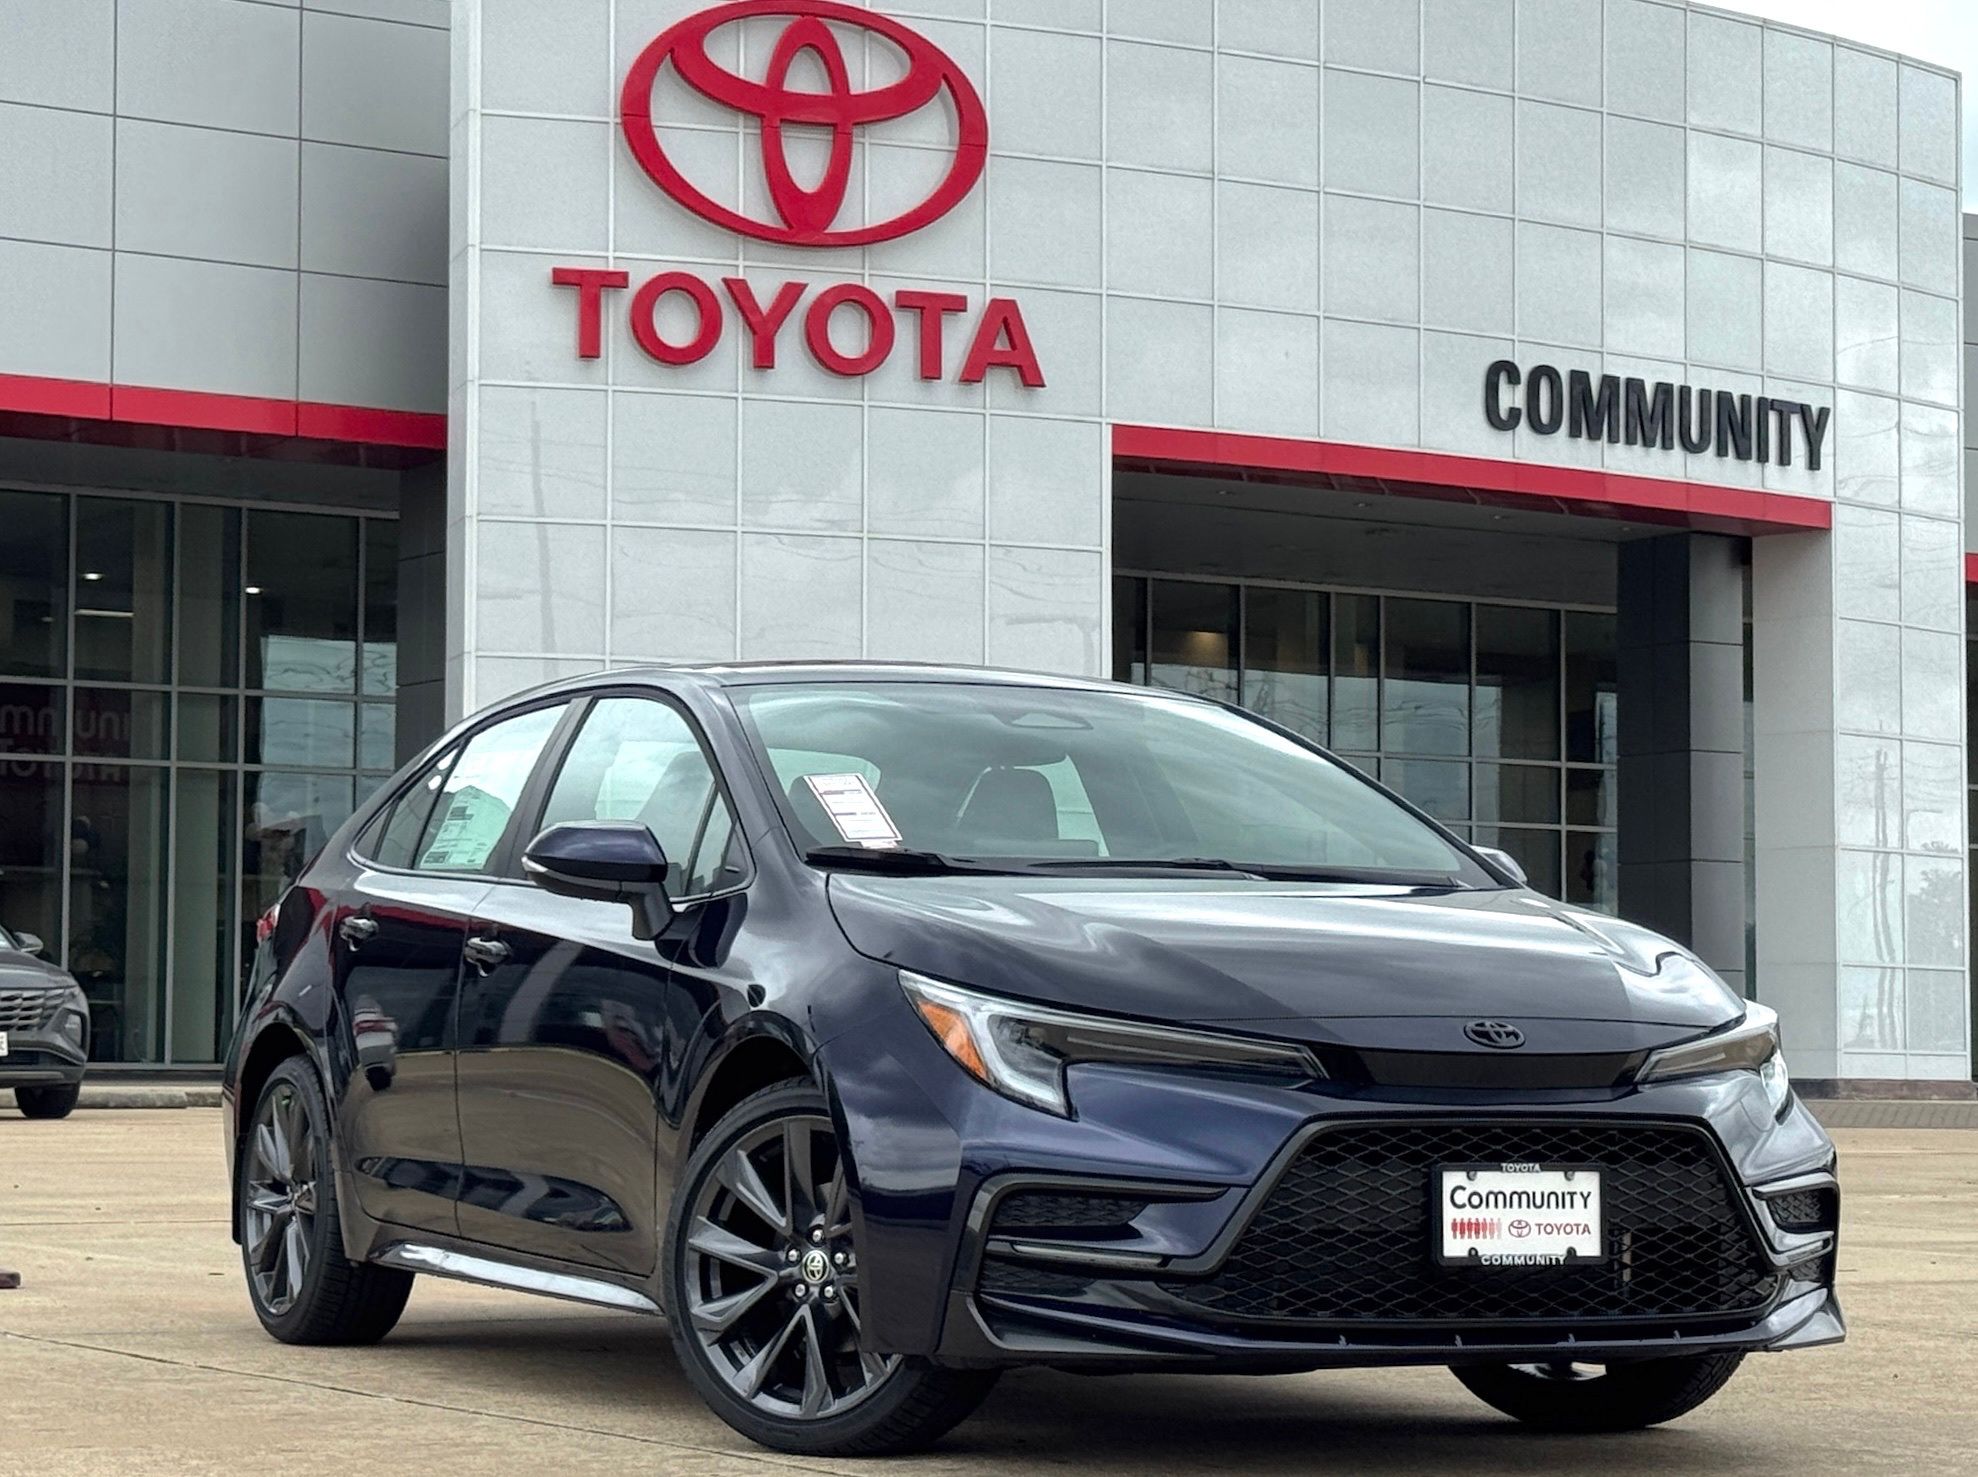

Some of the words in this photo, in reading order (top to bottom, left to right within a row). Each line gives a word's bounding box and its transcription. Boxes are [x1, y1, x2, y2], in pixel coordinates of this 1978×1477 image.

[552, 267, 1047, 388] TOYOTA
[1484, 360, 1831, 471] COMMUNITY
[1501, 1163, 1541, 1173] TOYOTA
[1535, 1223, 1591, 1235] TOYOTA
[1481, 1254, 1567, 1265] COMMUNITY
